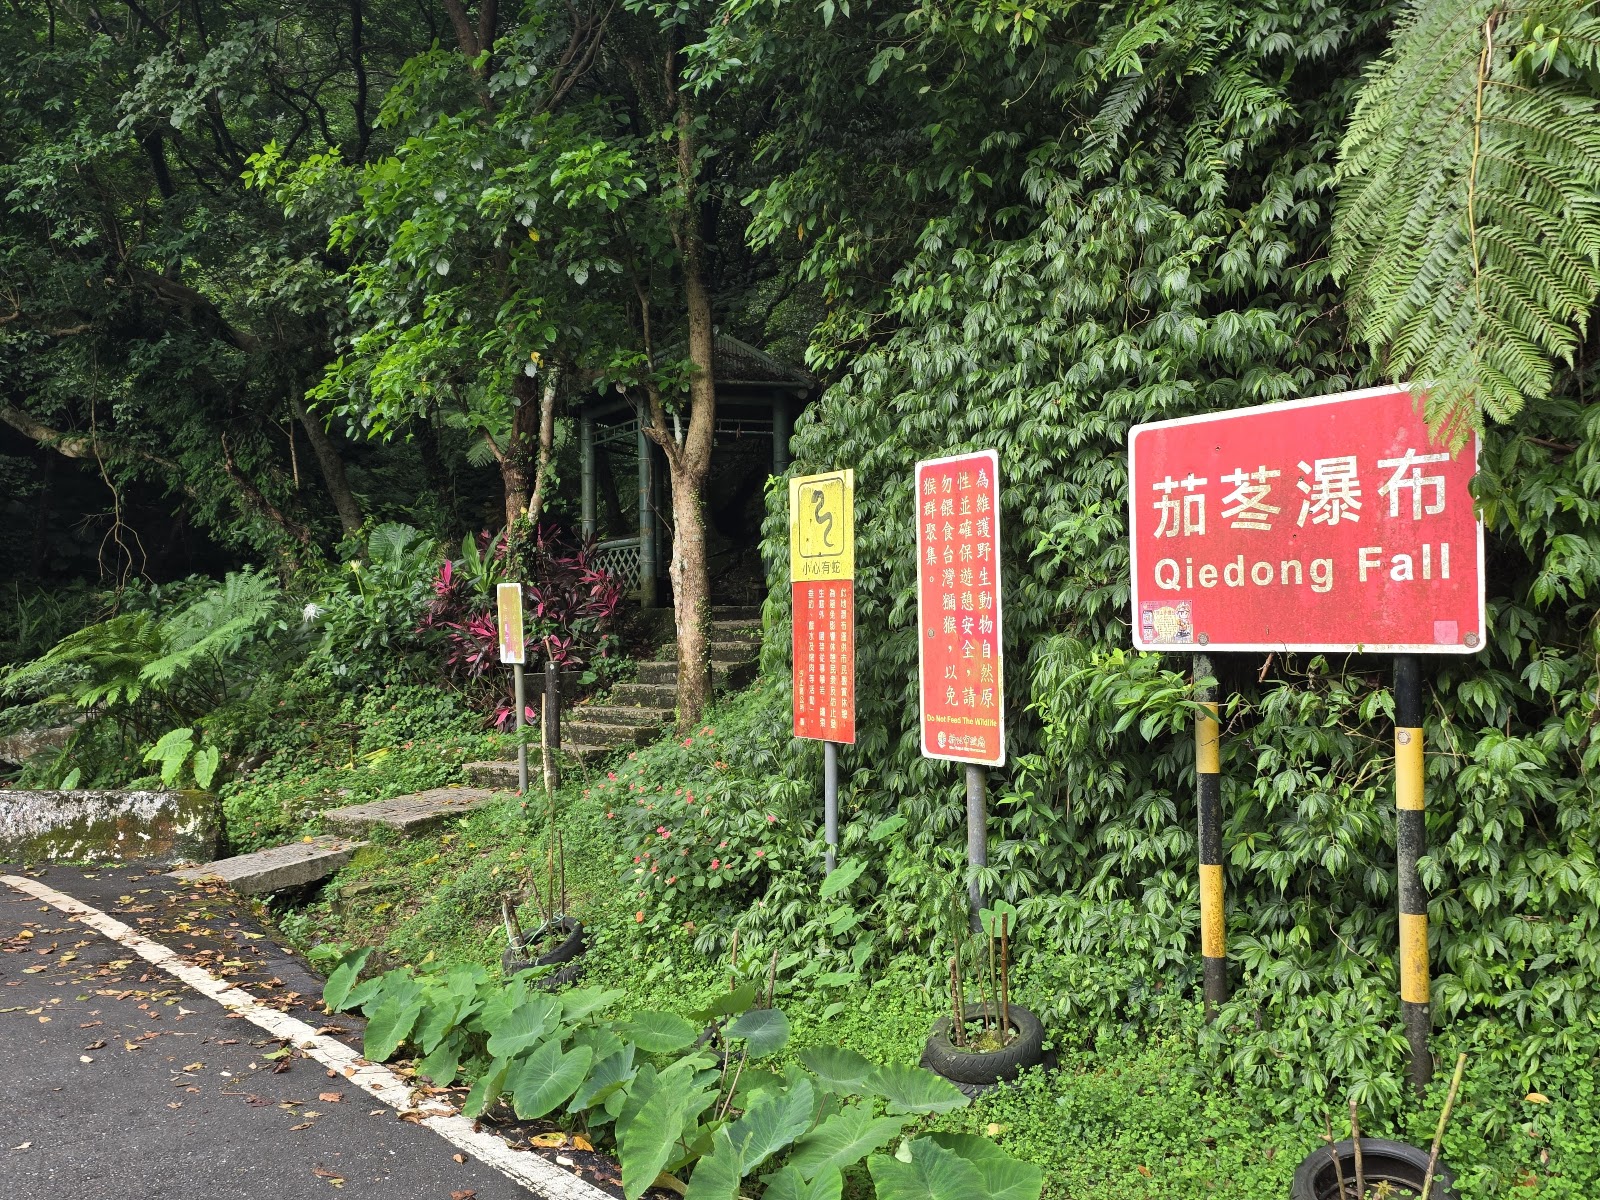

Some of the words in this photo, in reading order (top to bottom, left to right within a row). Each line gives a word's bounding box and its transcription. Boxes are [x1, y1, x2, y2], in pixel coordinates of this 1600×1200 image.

[923, 477, 938, 583] 猴群聚集。
[1152, 448, 1450, 539] 茄苳瀑布
[803, 560, 841, 575] 小心有蛇
[940, 474, 959, 707] 勿餵食台灣獼猴，以免
[956, 471, 976, 708] 性並確保遊憩安全，請
[975, 468, 995, 708] 為維護野生動物自然原
[1154, 554, 1334, 593] Qiedong
[1358, 542, 1451, 583] Fall
[926, 713, 935, 722] Do
[936, 715, 946, 723] Not
[947, 716, 962, 724] Feed
[962, 717, 974, 725] The
[974, 718, 998, 727] Wildlife
